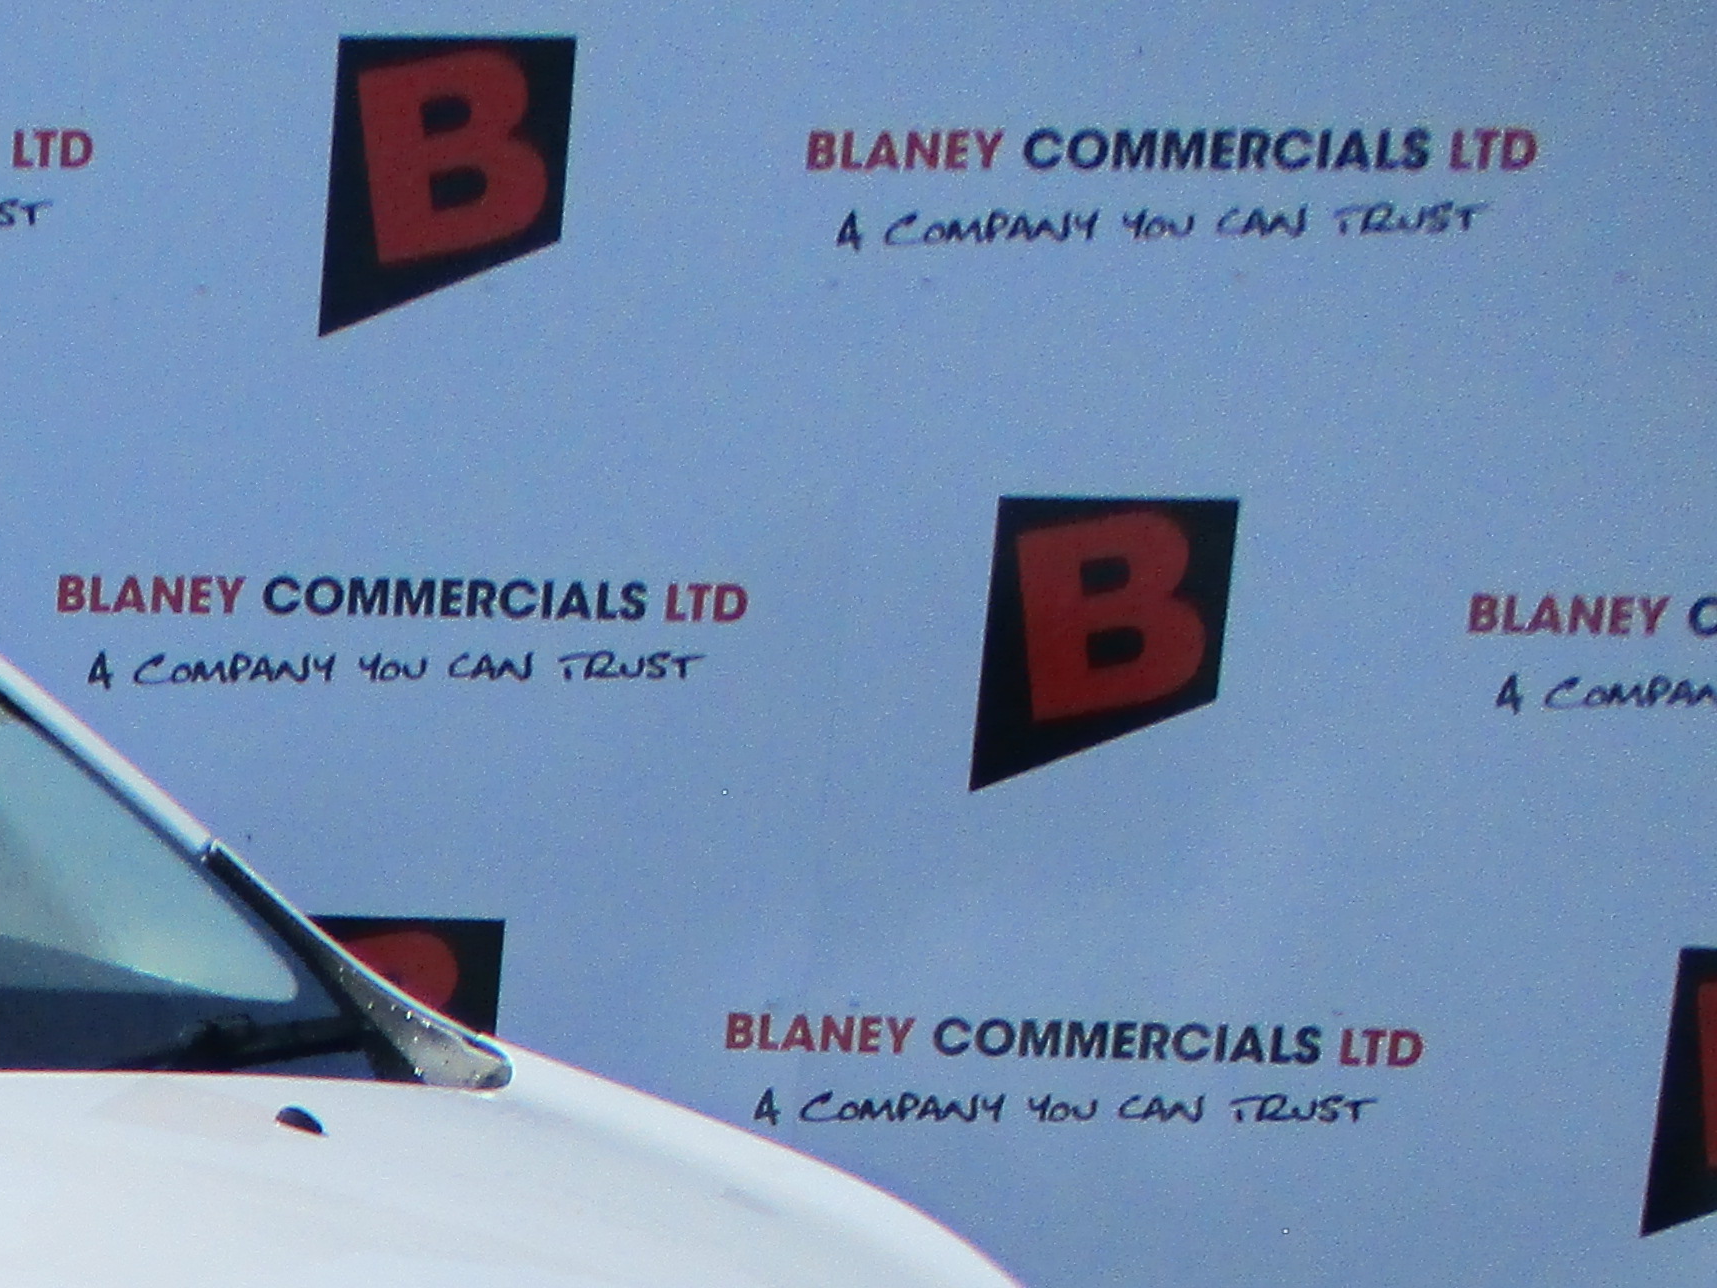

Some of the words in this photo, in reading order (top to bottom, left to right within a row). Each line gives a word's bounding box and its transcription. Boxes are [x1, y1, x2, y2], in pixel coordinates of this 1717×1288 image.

[12, 129, 94, 170] LTD
[358, 50, 549, 268] B
[806, 130, 1005, 172] BLANEY
[1021, 127, 1431, 173] COMMERCIALS
[1448, 128, 1539, 171] LTD
[836, 209, 863, 250] A
[882, 208, 1099, 248] COMPANY
[1123, 207, 1194, 240] YOU
[1216, 205, 1308, 238] CAN
[1333, 201, 1491, 235] TRUST
[57, 574, 247, 615] BLANEY
[262, 575, 648, 622] COMMERCIALS
[665, 581, 749, 625] LTD
[1016, 510, 1207, 723] B
[1467, 593, 1672, 636] BLANEY
[88, 650, 112, 687] A
[133, 651, 336, 685] COMPANY
[359, 652, 428, 682] YOU
[448, 650, 534, 682] CAN
[558, 651, 707, 682] TRUST
[1496, 673, 1524, 715] A
[725, 1012, 916, 1055] BLANEY
[933, 1016, 1321, 1066] COMMERCIALS
[1340, 1026, 1425, 1069] LTD
[754, 1089, 780, 1126] A
[800, 1090, 1005, 1124] COMPANY
[1028, 1095, 1098, 1124] YOU
[1118, 1093, 1204, 1124] CAN
[1230, 1094, 1378, 1124] TRUST
